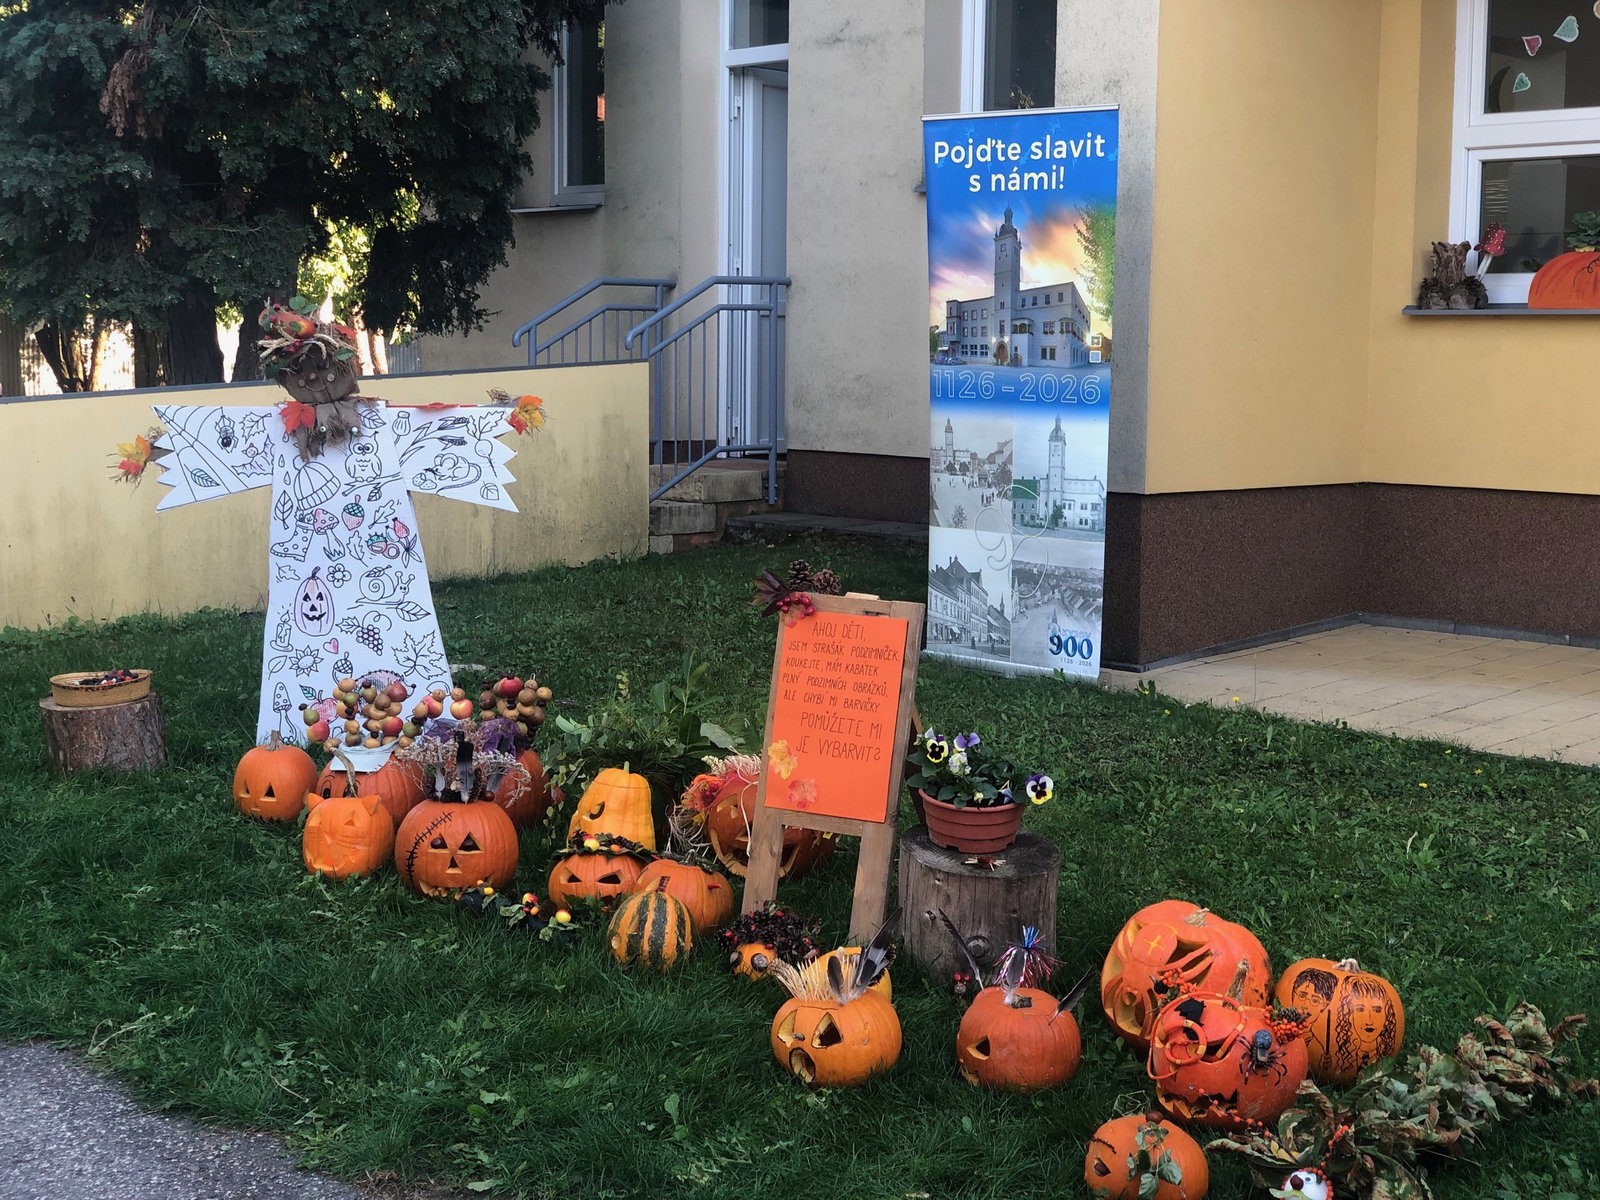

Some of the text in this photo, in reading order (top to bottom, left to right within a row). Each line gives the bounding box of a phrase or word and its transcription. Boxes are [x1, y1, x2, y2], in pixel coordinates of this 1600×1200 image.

[934, 131, 1106, 169] Pojďte slavit
[968, 164, 1066, 192] s námi!
[933, 369, 996, 400] 1126
[1019, 372, 1101, 405] 2026
[811, 621, 837, 638] AHOJ
[787, 640, 808, 652] JSEM
[812, 640, 845, 656] STRAŠÁK
[1049, 632, 1093, 660] 900
[785, 657, 880, 677] KOUKEJTE, MÁM KABÁTEK
[782, 671, 888, 698] PLNÝ PODZIMNÍCH OBRÁZKŮ,
[783, 689, 797, 702] ALE
[803, 691, 829, 705] CHYBÍ
[828, 696, 838, 707] MI
[800, 710, 883, 739] POMŮŽETE MI
[795, 735, 881, 764] JE VYBARVIT?
